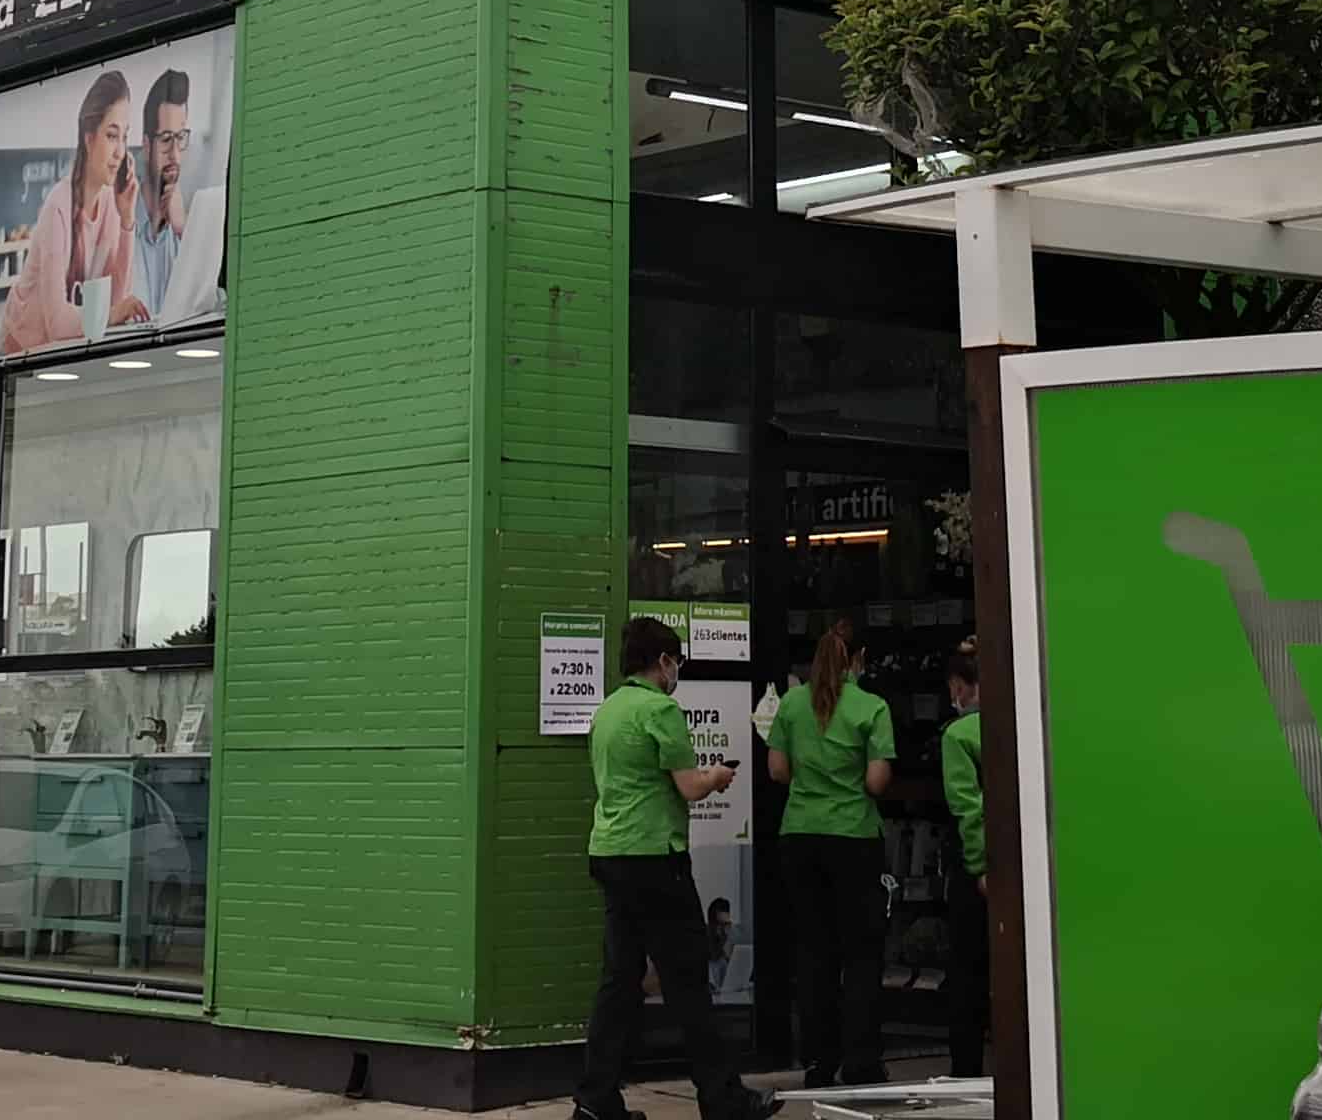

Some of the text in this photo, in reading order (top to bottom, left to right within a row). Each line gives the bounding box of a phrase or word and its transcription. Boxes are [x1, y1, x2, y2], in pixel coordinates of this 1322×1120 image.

[712, 628, 747, 641] clientes
[560, 663, 584, 676] 7:30
[585, 663, 593, 676] h
